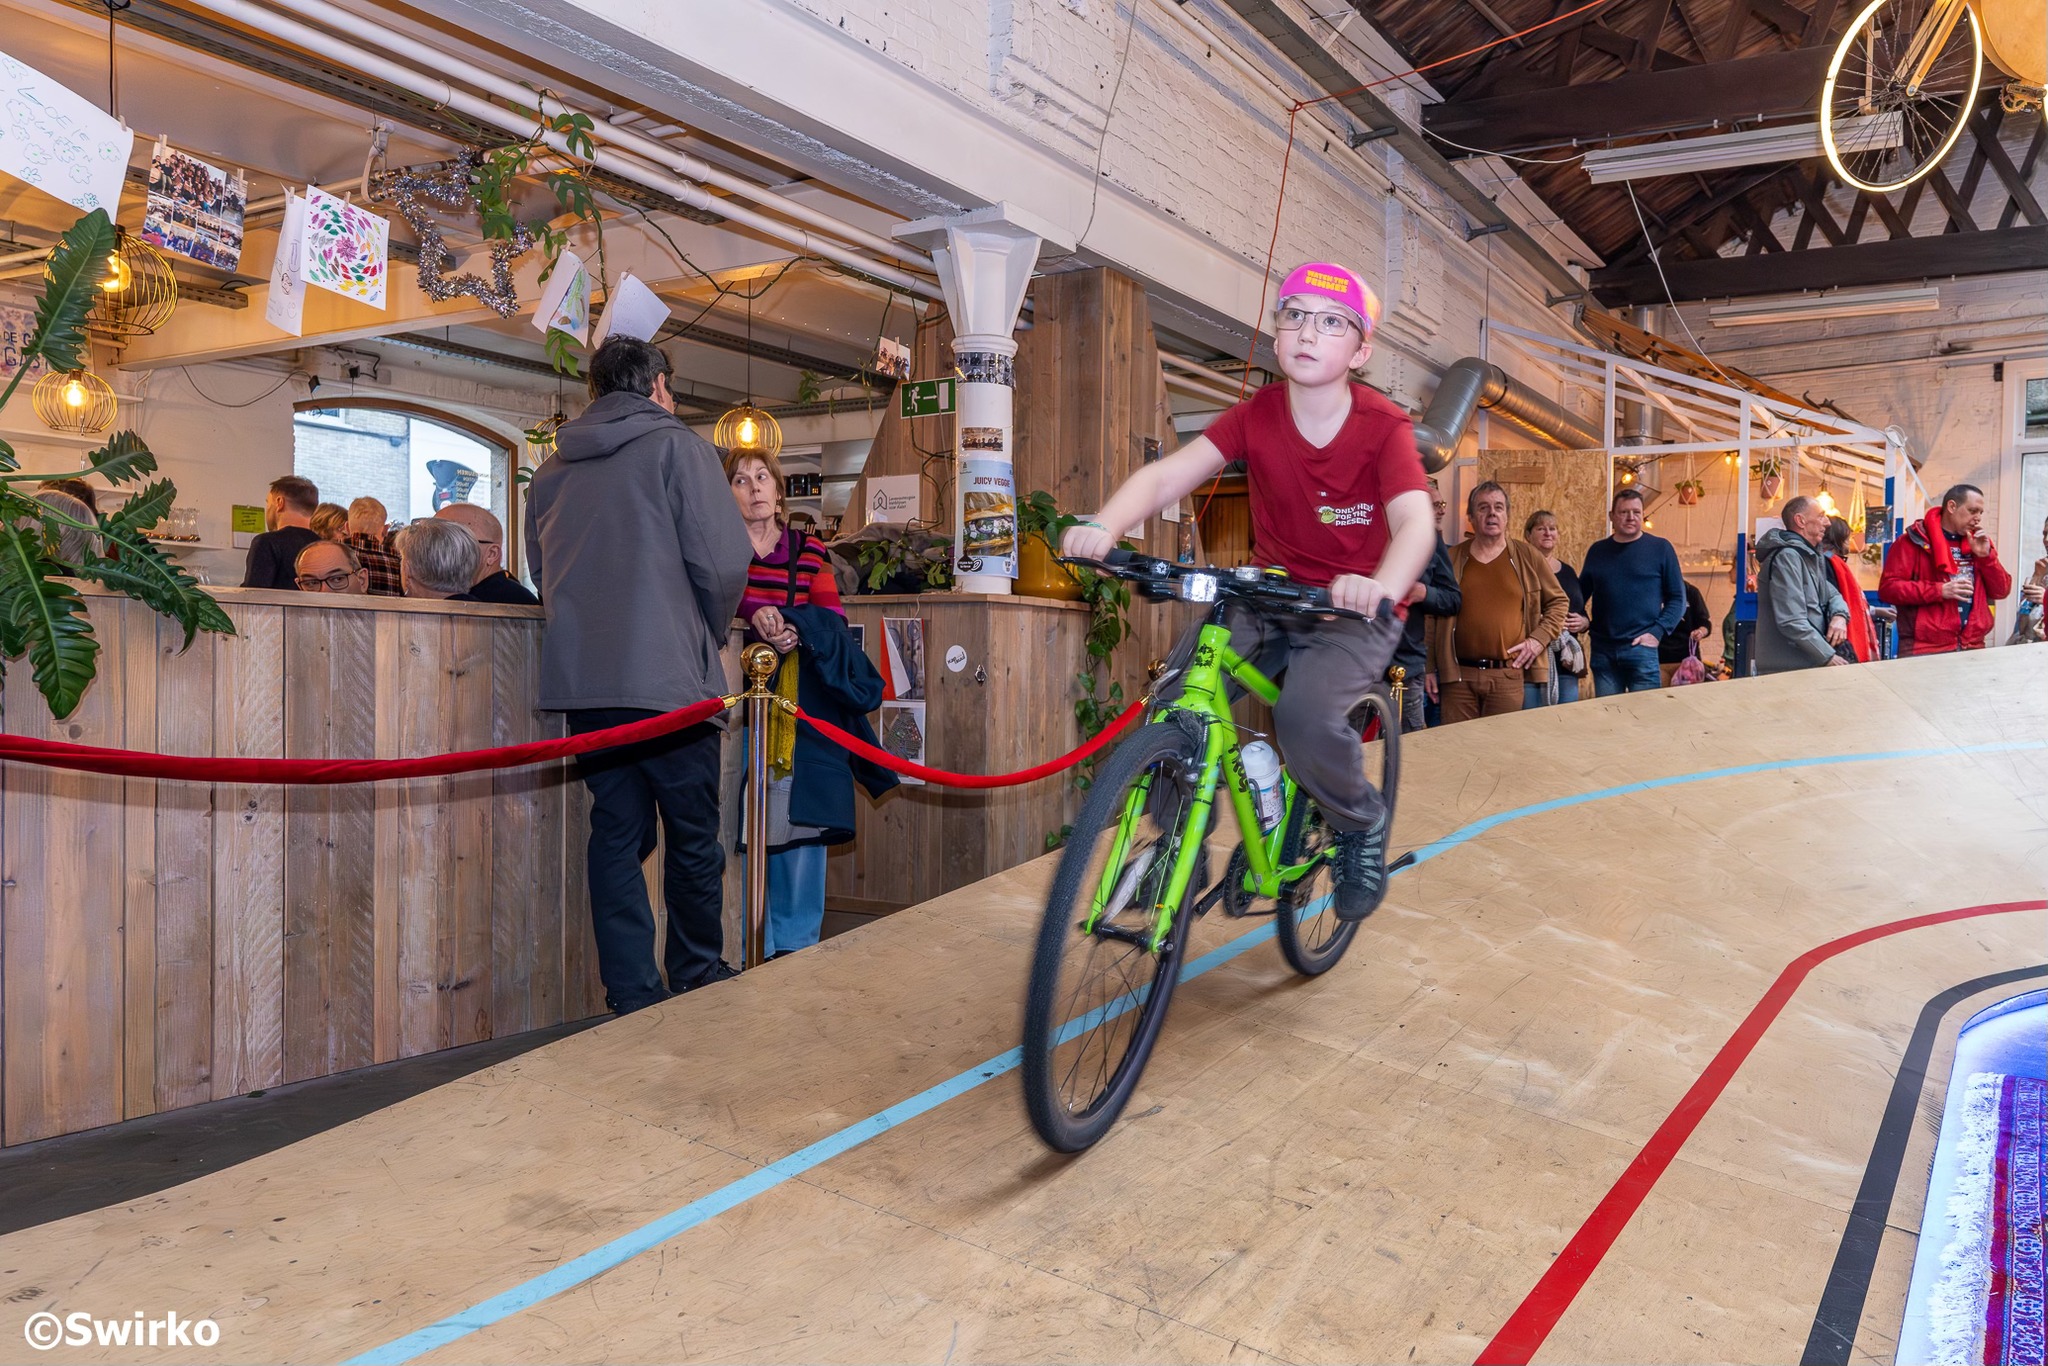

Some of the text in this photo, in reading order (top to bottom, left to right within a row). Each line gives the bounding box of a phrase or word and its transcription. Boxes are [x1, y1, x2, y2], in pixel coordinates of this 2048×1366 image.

[3, 330, 18, 343] DE
[973, 476, 1011, 488] JUICY VEGGIE
[1335, 506, 1357, 514] ONLY
[1352, 509, 1368, 518] THE
